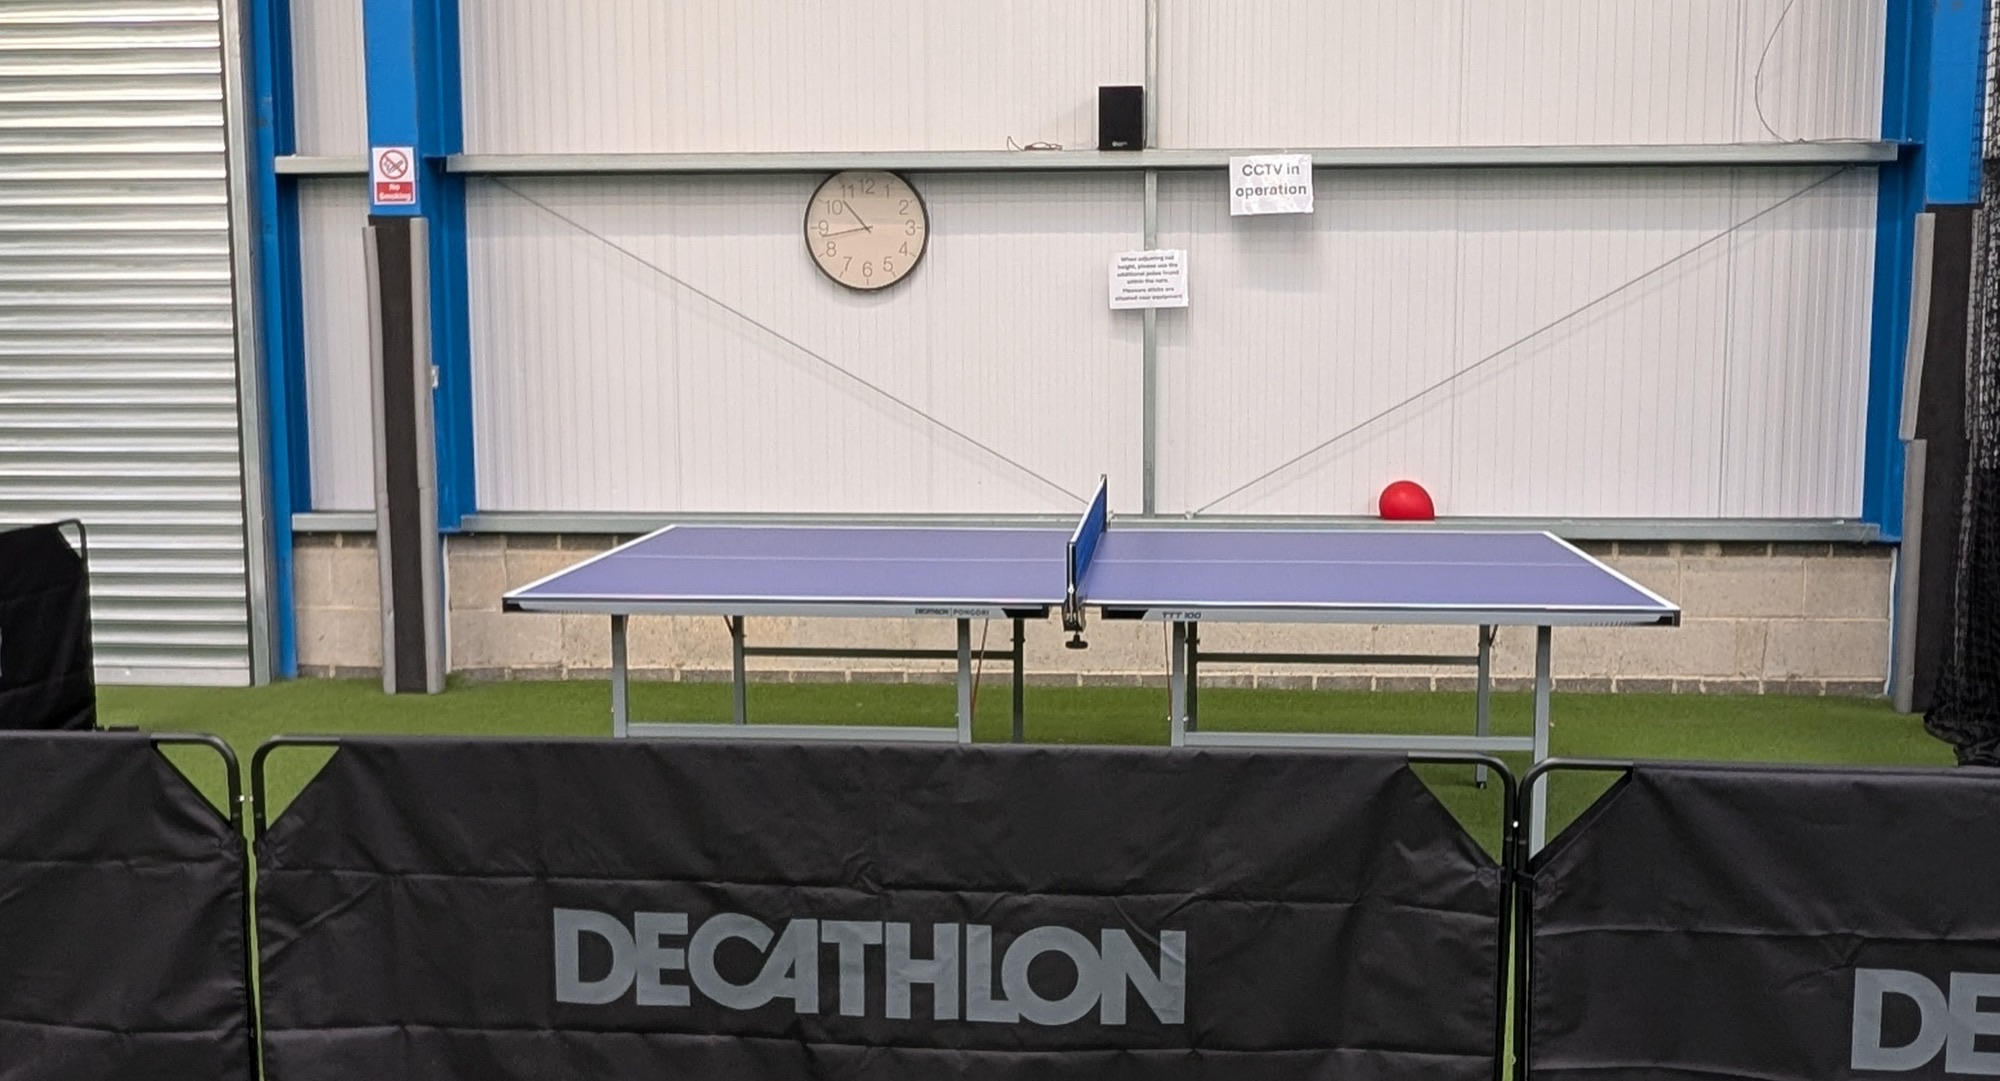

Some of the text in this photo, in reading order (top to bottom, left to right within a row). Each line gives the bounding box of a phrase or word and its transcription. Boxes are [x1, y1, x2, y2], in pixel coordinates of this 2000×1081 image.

[1242, 162, 1300, 177] CCTV in
[389, 183, 401, 192] No
[841, 184, 854, 198] 11
[860, 178, 875, 195] 12
[885, 184, 890, 198] 1
[1235, 182, 1307, 200] operation
[378, 191, 412, 201] Smoking
[826, 199, 843, 215] 10
[898, 199, 909, 215] 2
[818, 219, 829, 236] 9
[905, 219, 916, 236] 3
[826, 241, 837, 257] 8
[898, 241, 908, 257] 4
[843, 256, 853, 272] 7
[862, 261, 873, 278] 6
[883, 256, 893, 272] 5
[553, 907, 1187, 1027] DECATHLON
[1851, 967, 2000, 1076] DE
